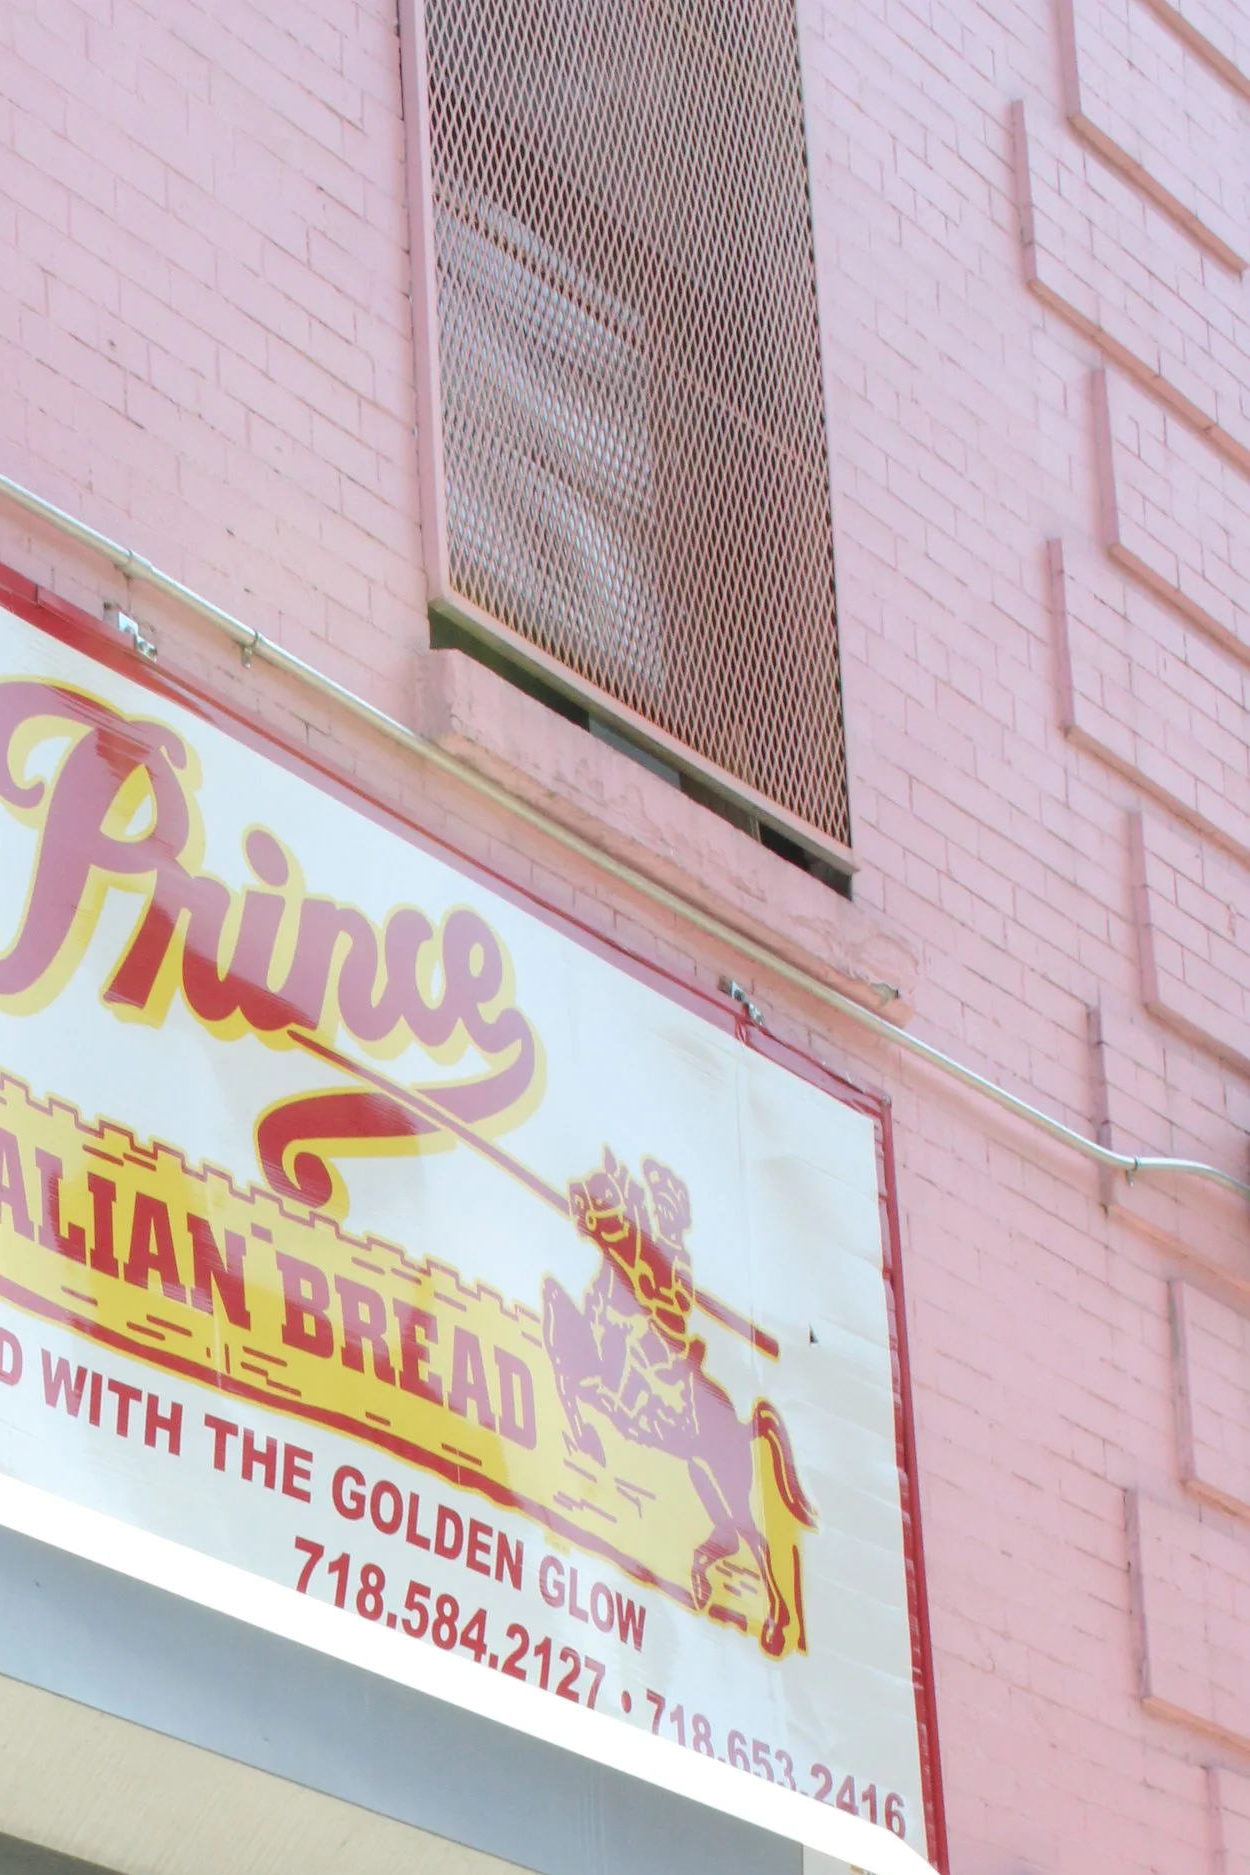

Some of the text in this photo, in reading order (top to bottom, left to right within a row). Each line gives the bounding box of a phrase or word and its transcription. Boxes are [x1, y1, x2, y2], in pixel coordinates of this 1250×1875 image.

[276, 1243, 538, 1452] BREAD
[40, 1347, 185, 1456] WITH
[203, 1412, 314, 1504] THE
[331, 1464, 526, 1592] GOLDEN
[537, 1554, 647, 1654] GLOW
[294, 1535, 606, 1711] 718.584.2127
